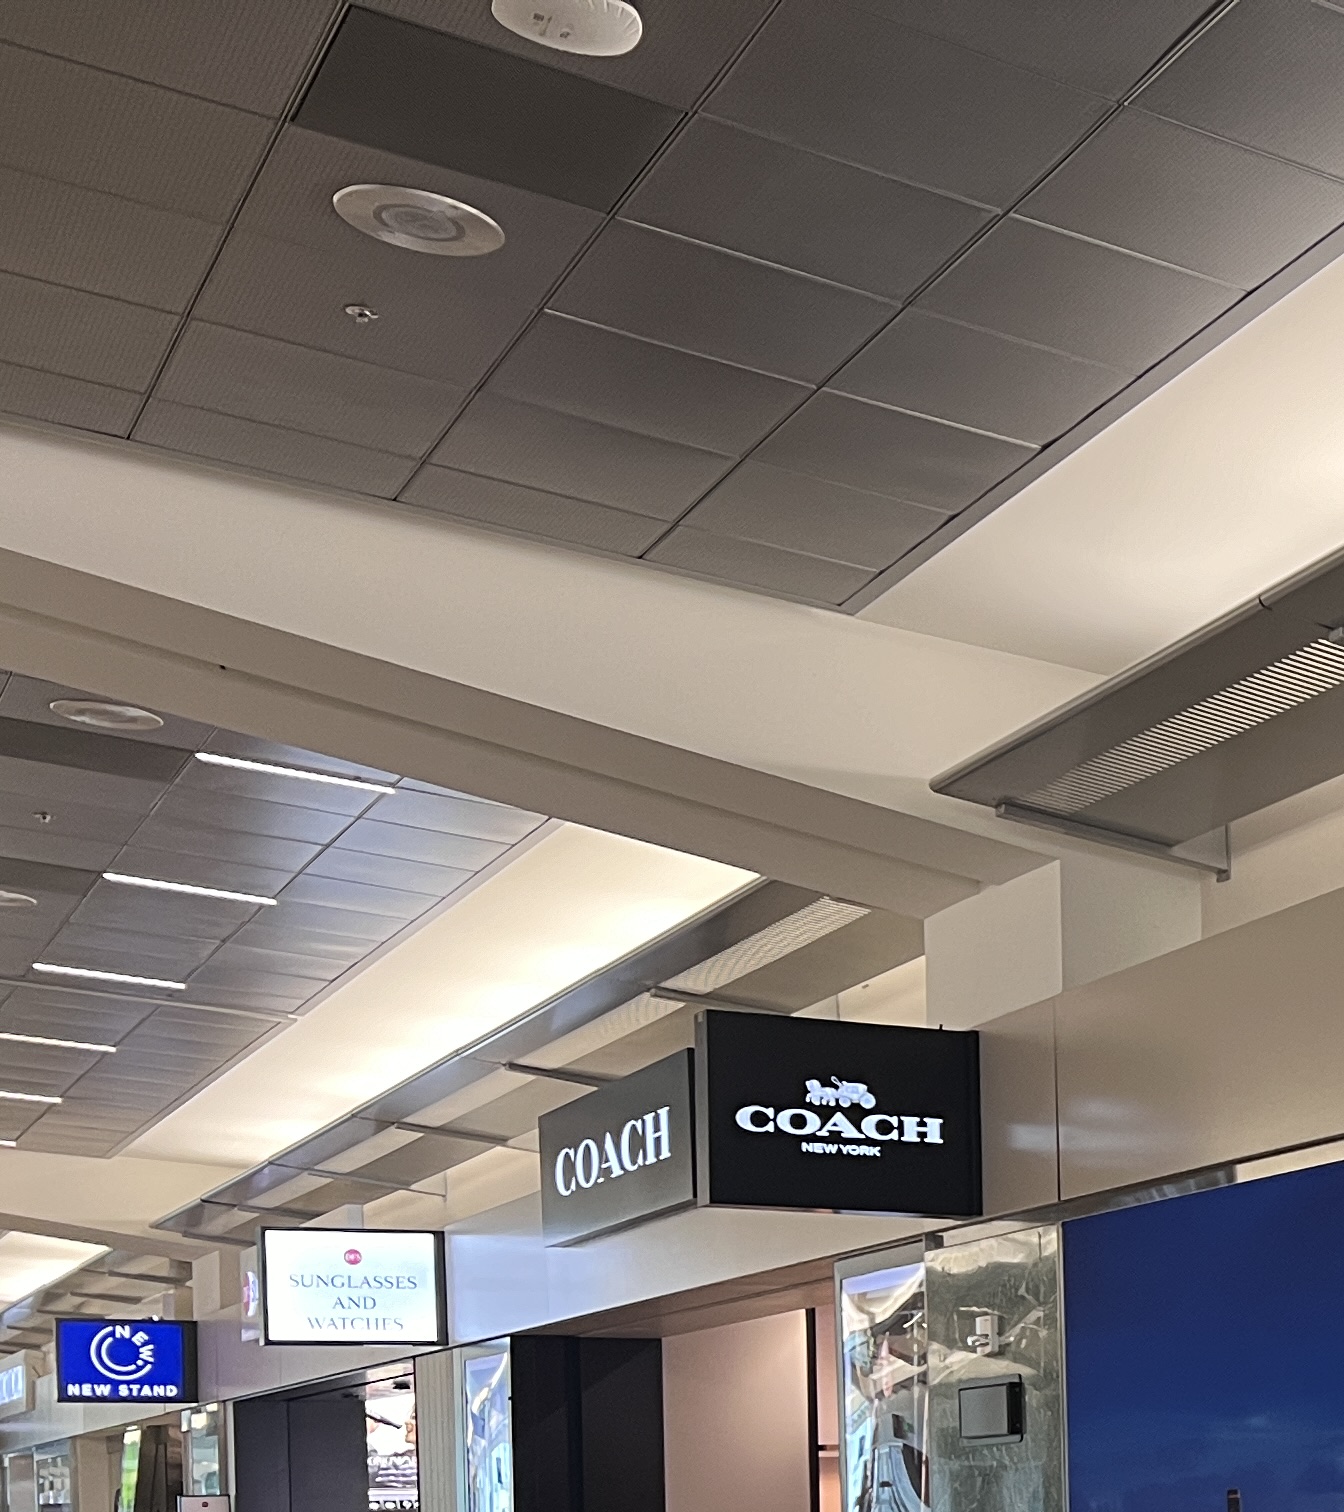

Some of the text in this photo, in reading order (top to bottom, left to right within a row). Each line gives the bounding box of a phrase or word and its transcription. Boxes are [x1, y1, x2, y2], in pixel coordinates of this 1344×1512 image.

[735, 1105, 944, 1145] COACH
[554, 1105, 671, 1197] COACH
[801, 1141, 881, 1158] NEW YORK
[289, 1274, 418, 1290] SUNGLASSES
[332, 1296, 377, 1310] AND
[307, 1316, 404, 1331] WATCHES
[67, 1383, 178, 1397] NEW STAND
